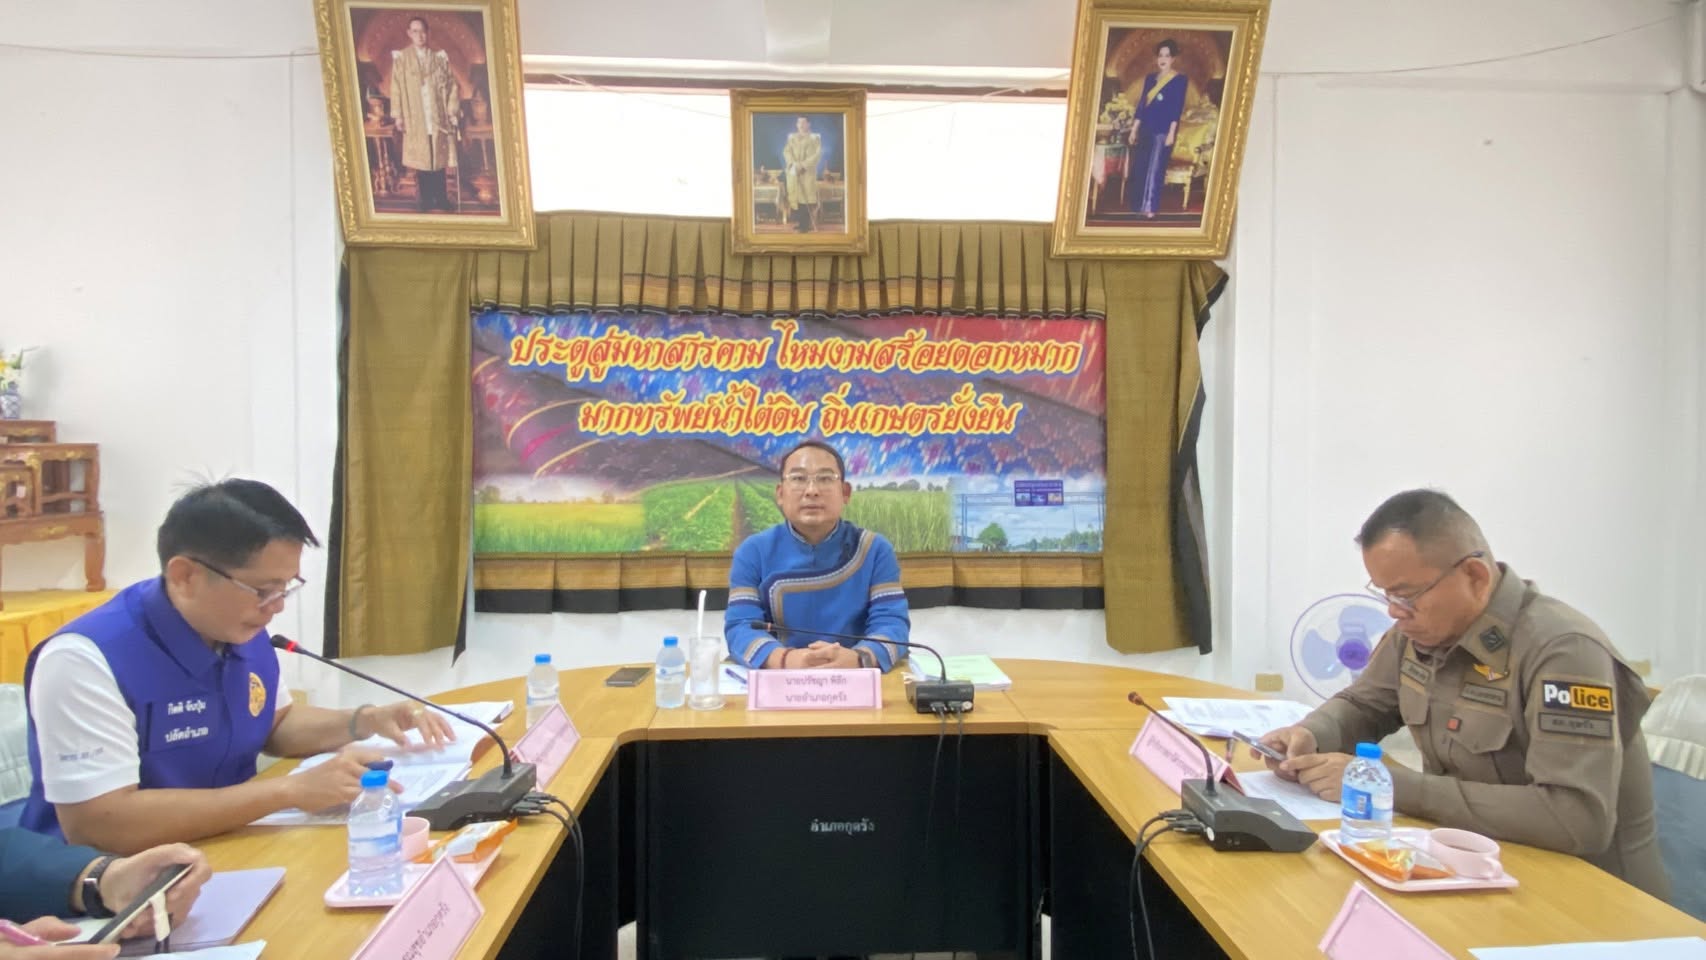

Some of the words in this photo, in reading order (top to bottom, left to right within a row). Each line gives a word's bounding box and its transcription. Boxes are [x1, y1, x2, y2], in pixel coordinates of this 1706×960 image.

[509, 326, 773, 381] ประตูสู่มหาสารคาม
[772, 319, 1083, 373] ไหมงามสร้อยดอกหมาก
[579, 381, 817, 436] มากทรัพย์น้ำใต้ดิน
[821, 383, 1023, 437] ถิ่นเกษตรยั่งยืน
[1544, 684, 1609, 708] Police
[810, 818, 875, 835] อำเภอกุดรัง
